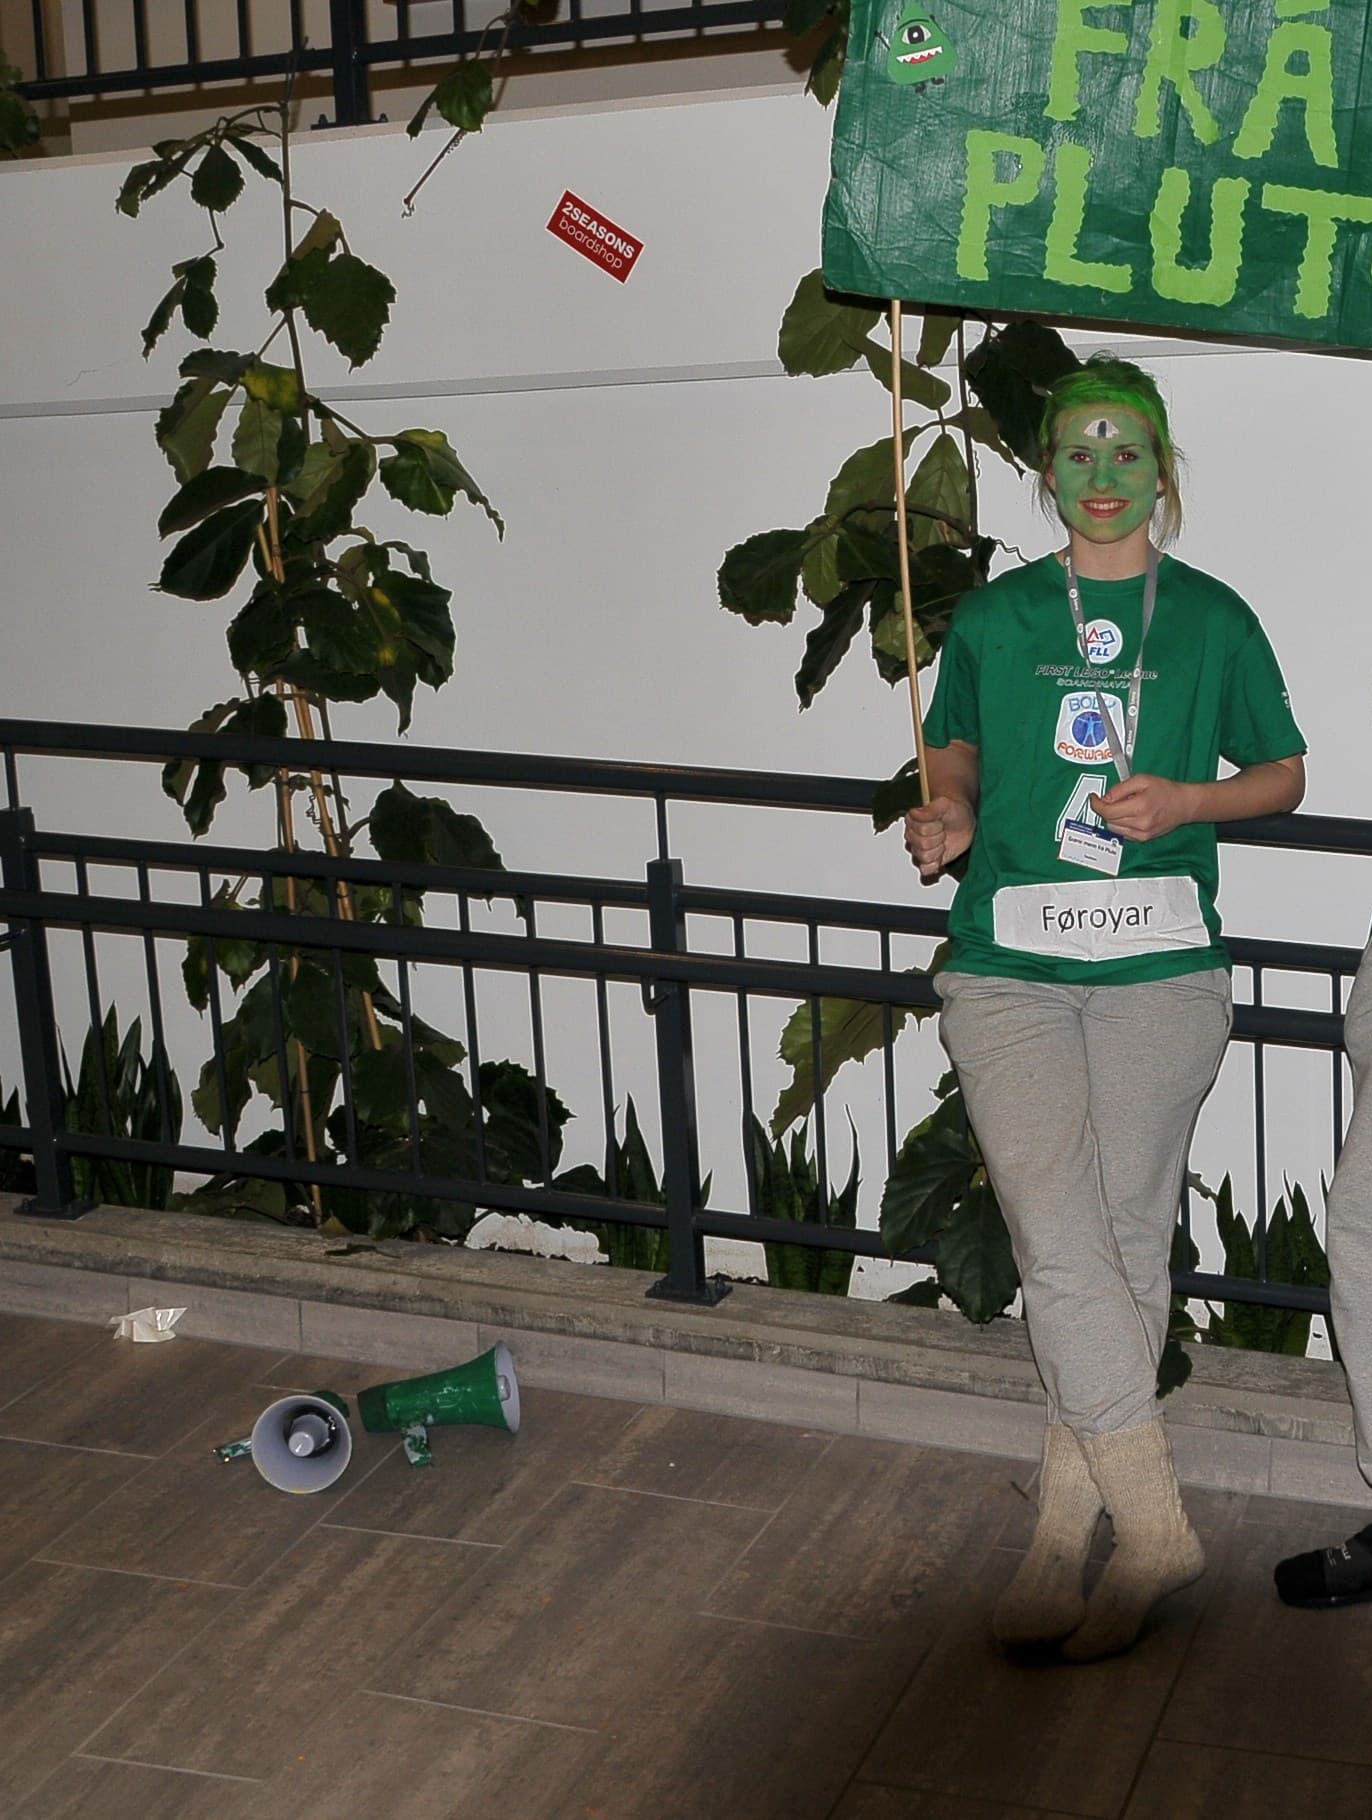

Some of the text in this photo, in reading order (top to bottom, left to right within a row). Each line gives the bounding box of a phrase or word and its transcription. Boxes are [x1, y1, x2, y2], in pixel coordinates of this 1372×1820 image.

[562, 201, 635, 259] 2SEASONS
[558, 216, 623, 269] boardshop
[1089, 646, 1110, 657] FLL
[1035, 664, 1074, 677] FIRST
[1057, 741, 1114, 761] FORWAR
[1042, 905, 1154, 934] Føroyar
